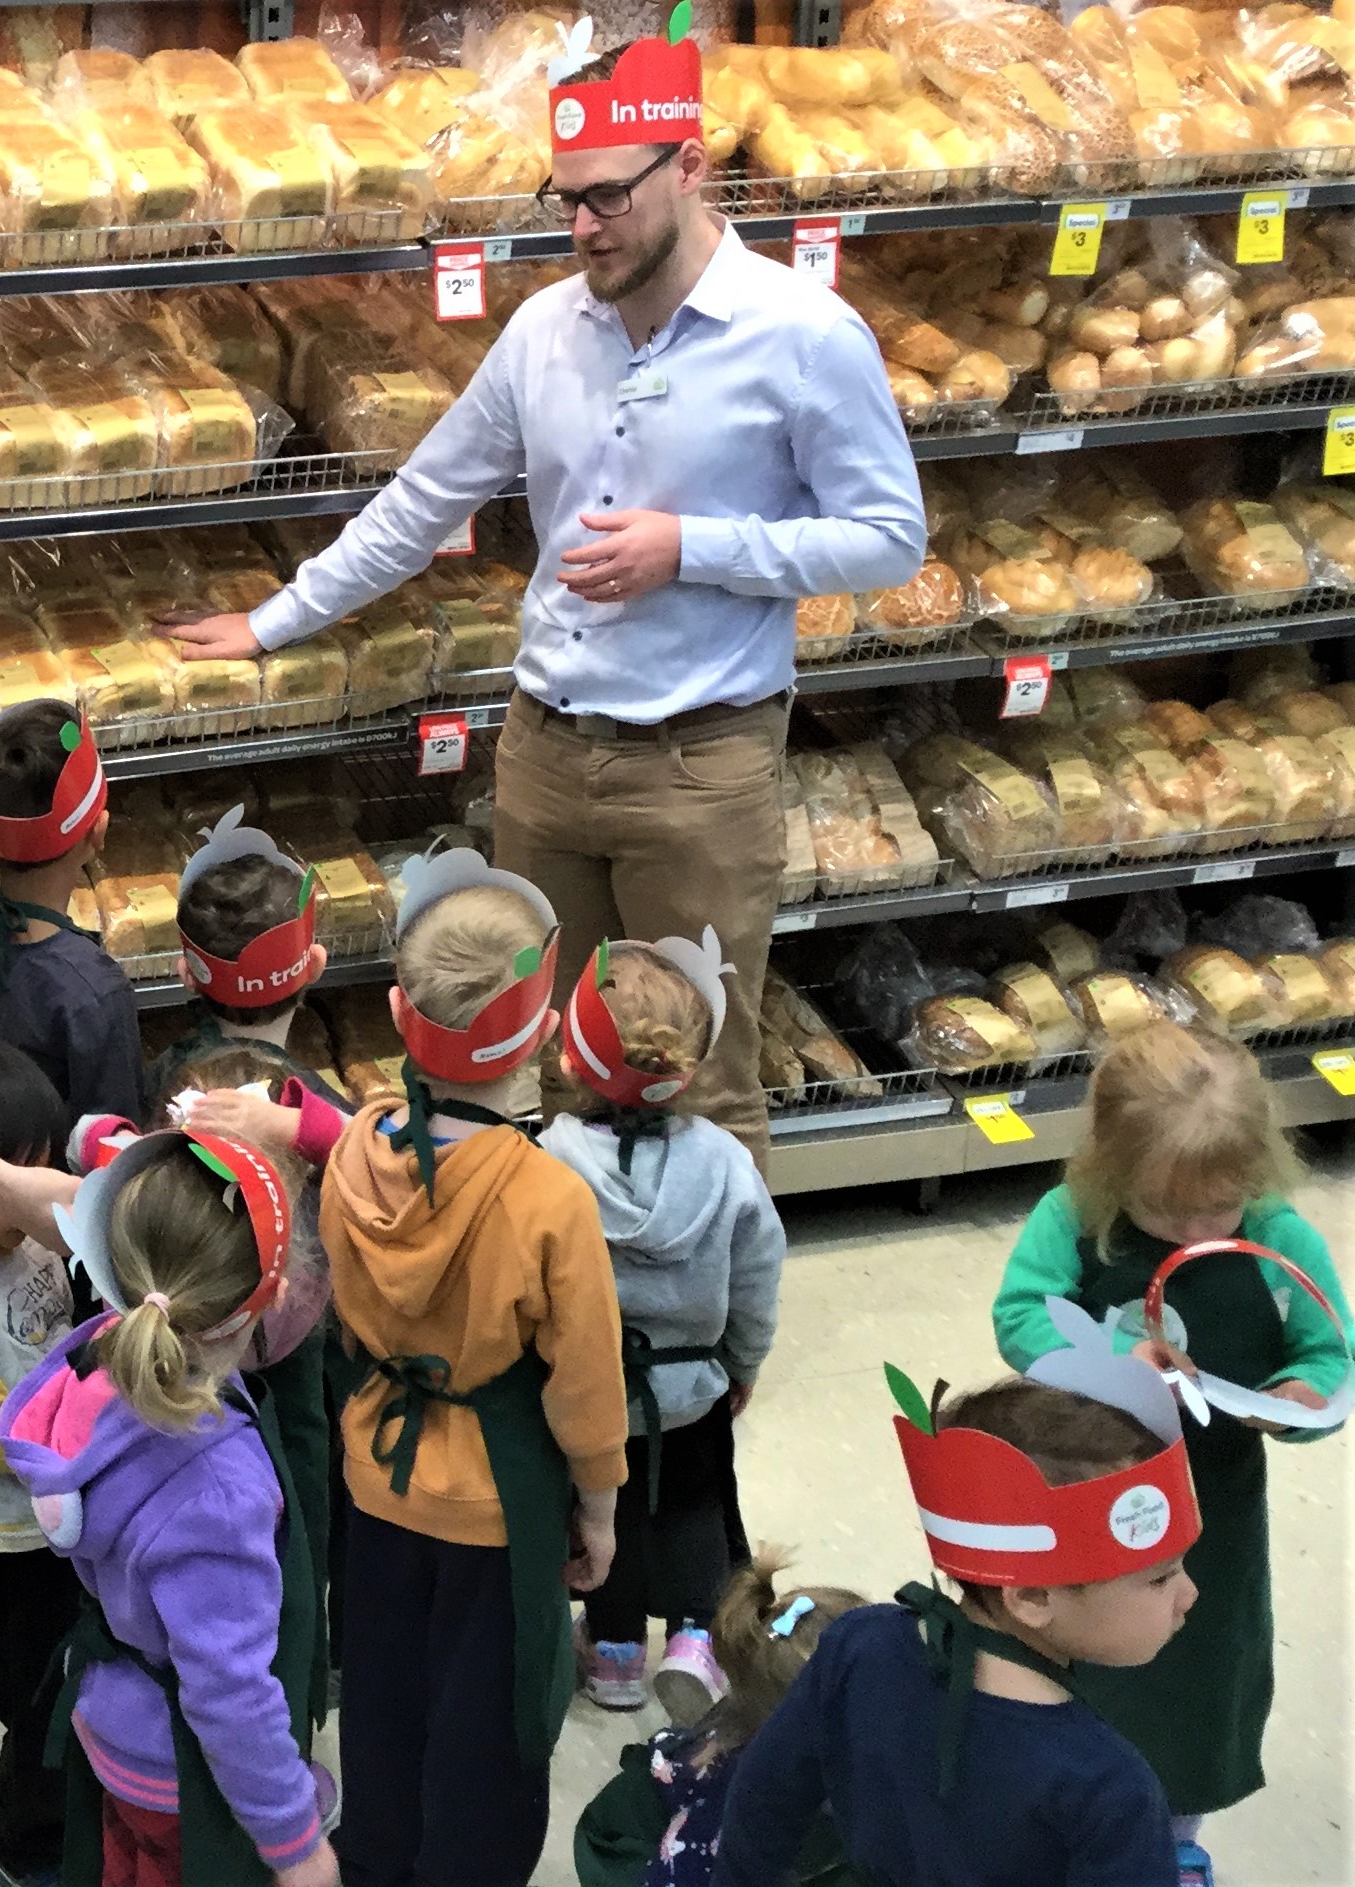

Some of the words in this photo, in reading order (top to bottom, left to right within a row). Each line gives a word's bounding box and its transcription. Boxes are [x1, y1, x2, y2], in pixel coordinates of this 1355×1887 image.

[612, 100, 636, 123] In
[1253, 219, 1269, 235] $3
[1071, 231, 1087, 247] $3
[207, 754, 223, 763] The
[224, 749, 258, 761] average
[258, 746, 280, 756] adult
[281, 743, 301, 753] daily
[302, 740, 331, 752] energy
[331, 737, 358, 748] intake
[237, 976, 265, 993] In
